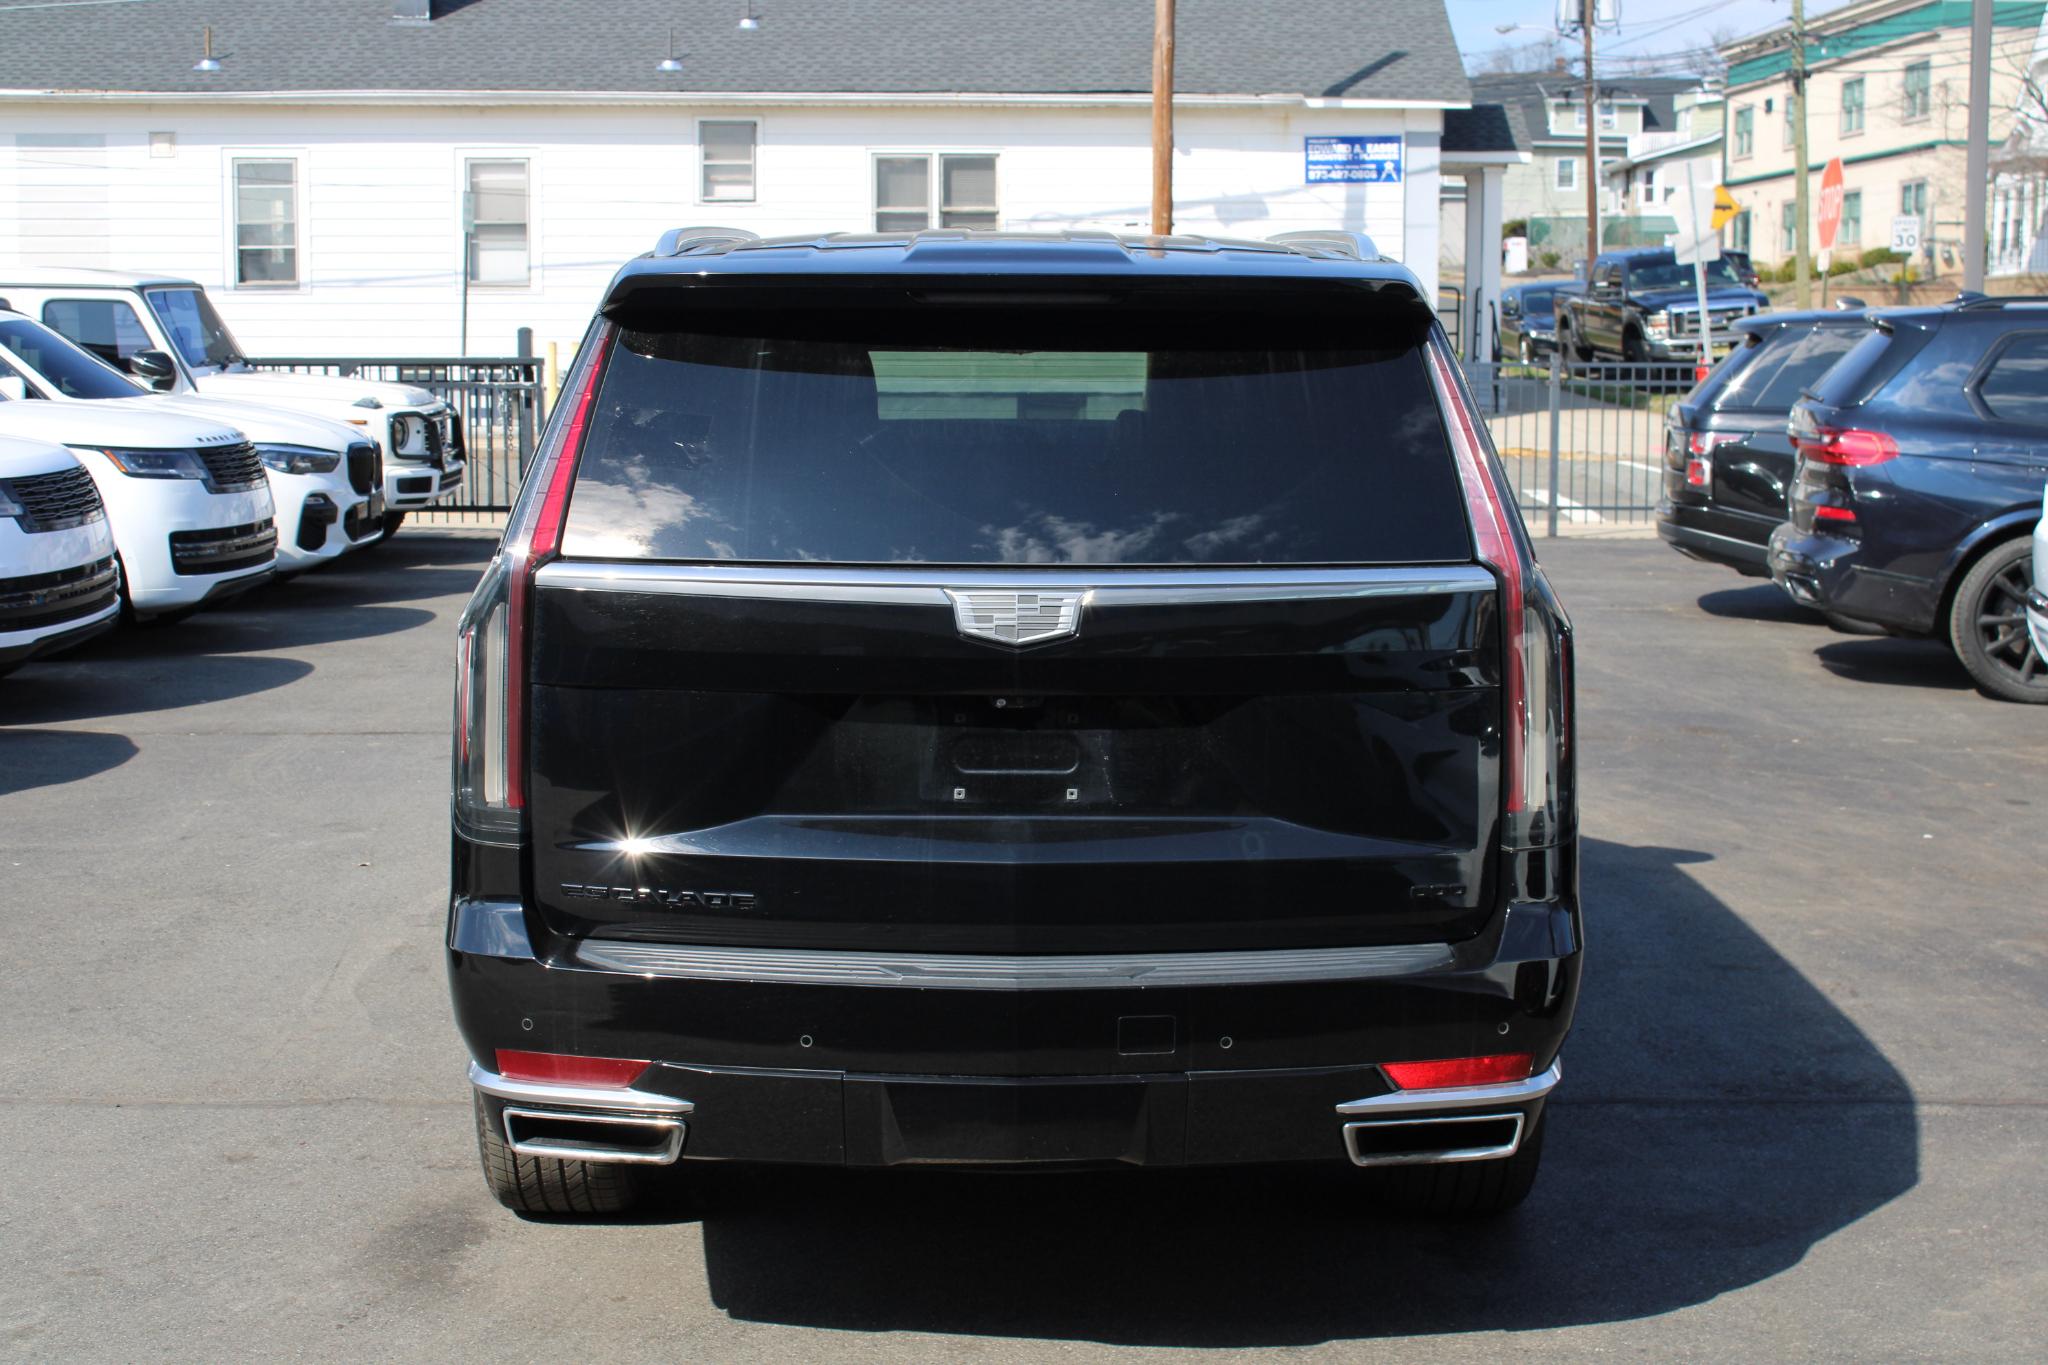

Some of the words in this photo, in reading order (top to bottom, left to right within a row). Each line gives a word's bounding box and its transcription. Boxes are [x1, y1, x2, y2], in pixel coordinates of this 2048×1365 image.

[1818, 184, 1841, 222] STOP
[1894, 233, 1917, 248] 30
[560, 883, 756, 910] ESCALADE
